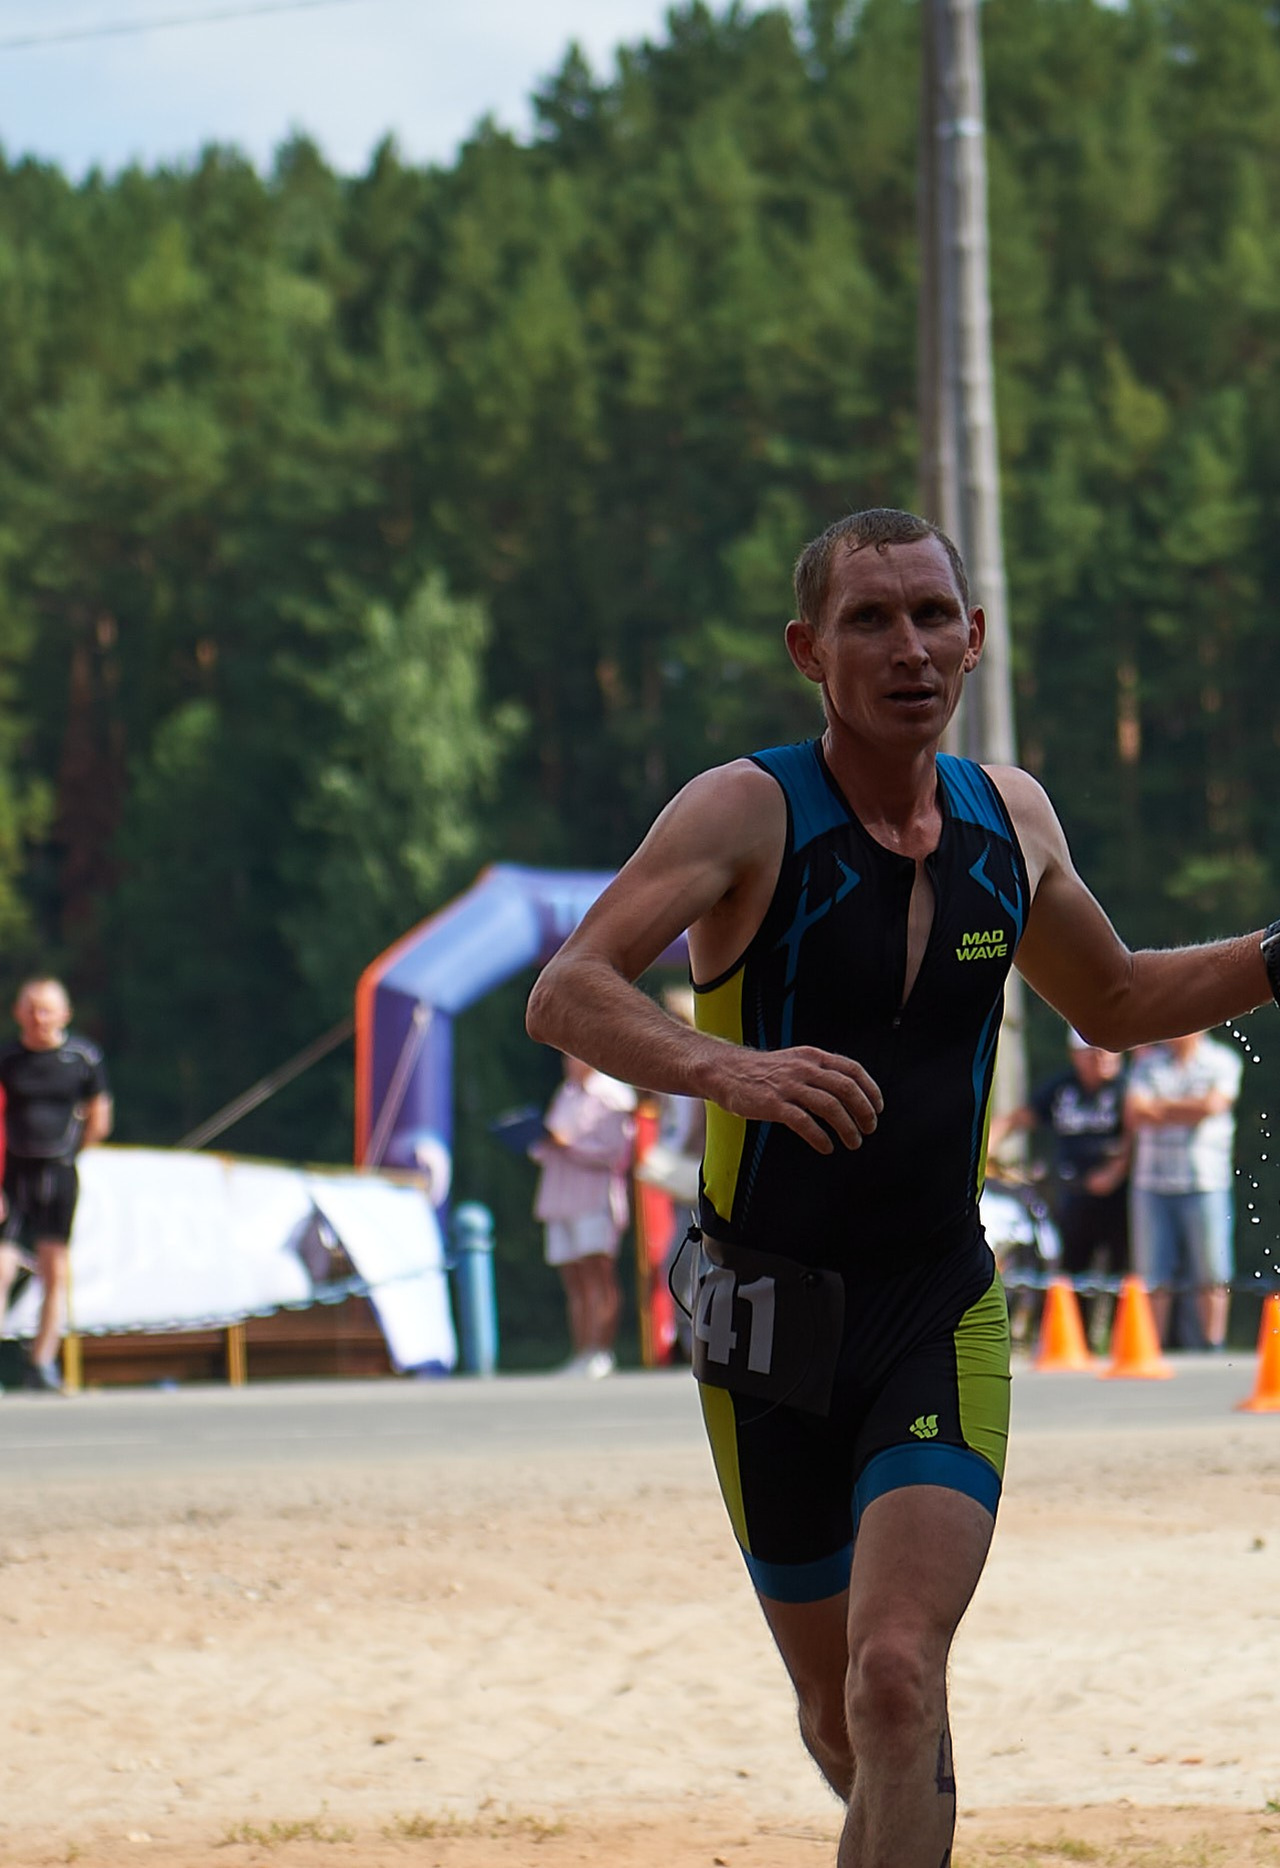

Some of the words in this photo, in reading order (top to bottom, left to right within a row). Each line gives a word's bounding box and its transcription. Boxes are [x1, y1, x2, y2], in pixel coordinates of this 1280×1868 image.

[962, 929, 1004, 945] MAD
[956, 944, 1008, 961] WAVE
[696, 1267, 776, 1375] 41
